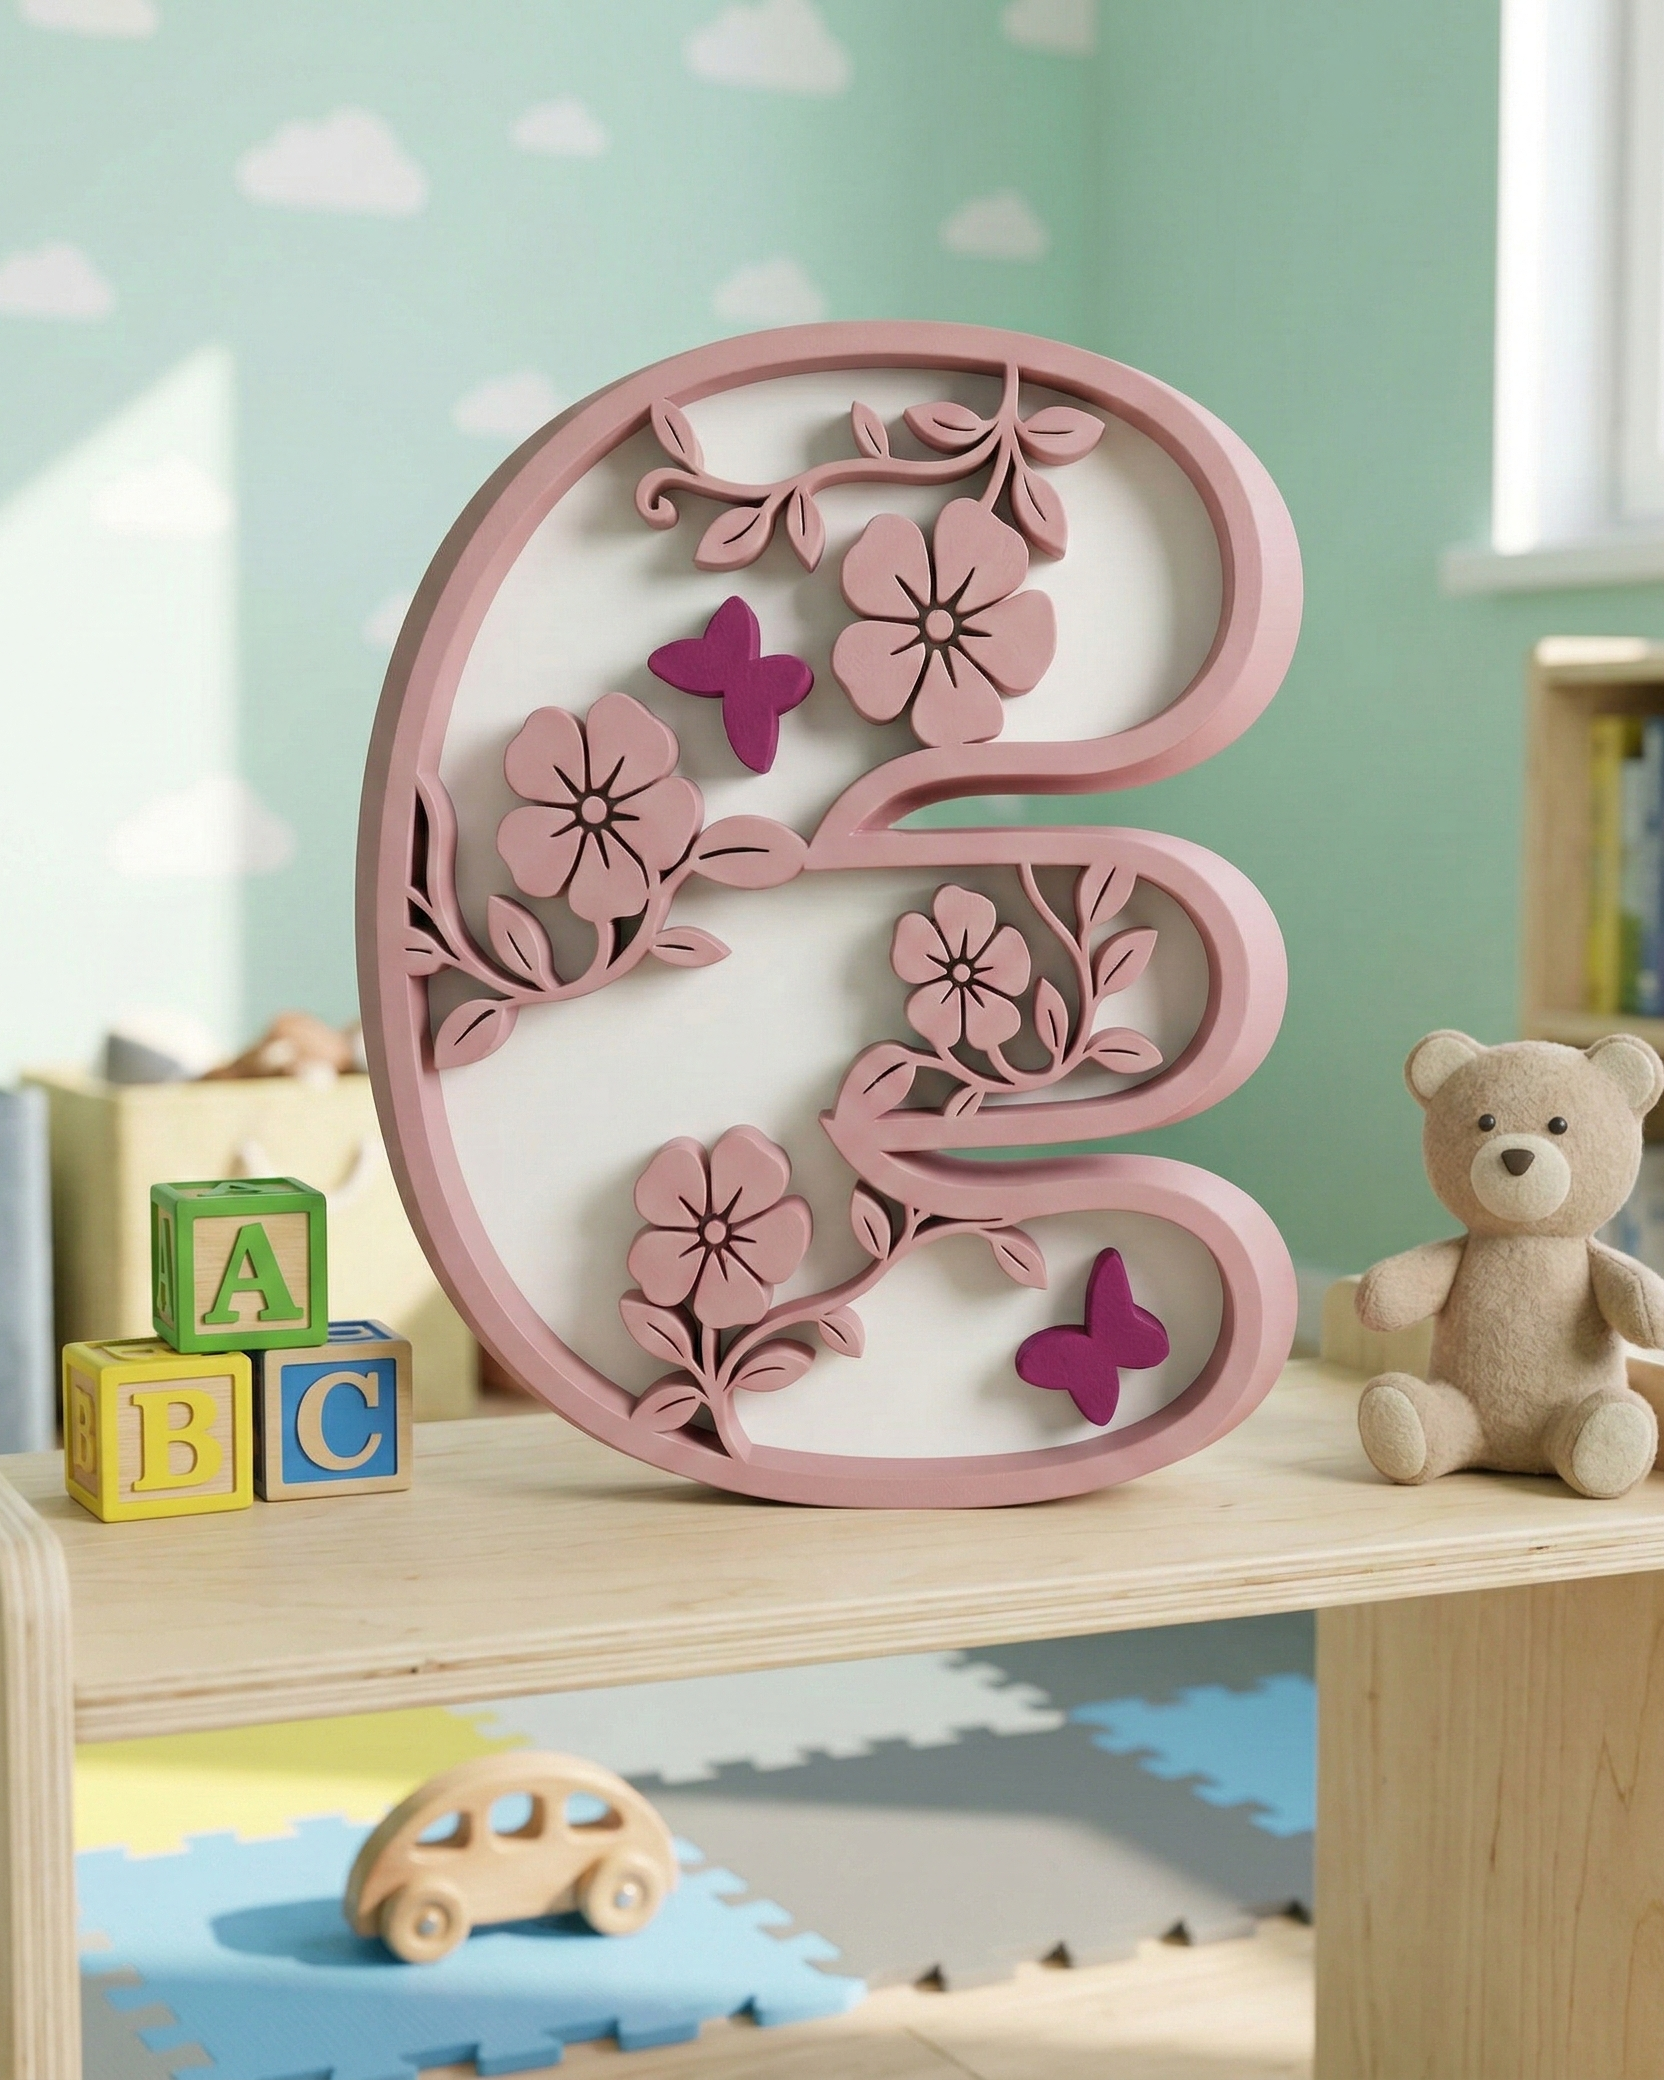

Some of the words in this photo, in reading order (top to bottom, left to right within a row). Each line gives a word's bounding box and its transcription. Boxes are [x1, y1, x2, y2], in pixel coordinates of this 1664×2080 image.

[356, 320, 1304, 1508] E
[157, 1217, 175, 1322] A
[202, 1222, 305, 1324] A
[74, 1385, 95, 1474] B
[131, 1388, 224, 1492] B
[297, 1370, 383, 1472] C
